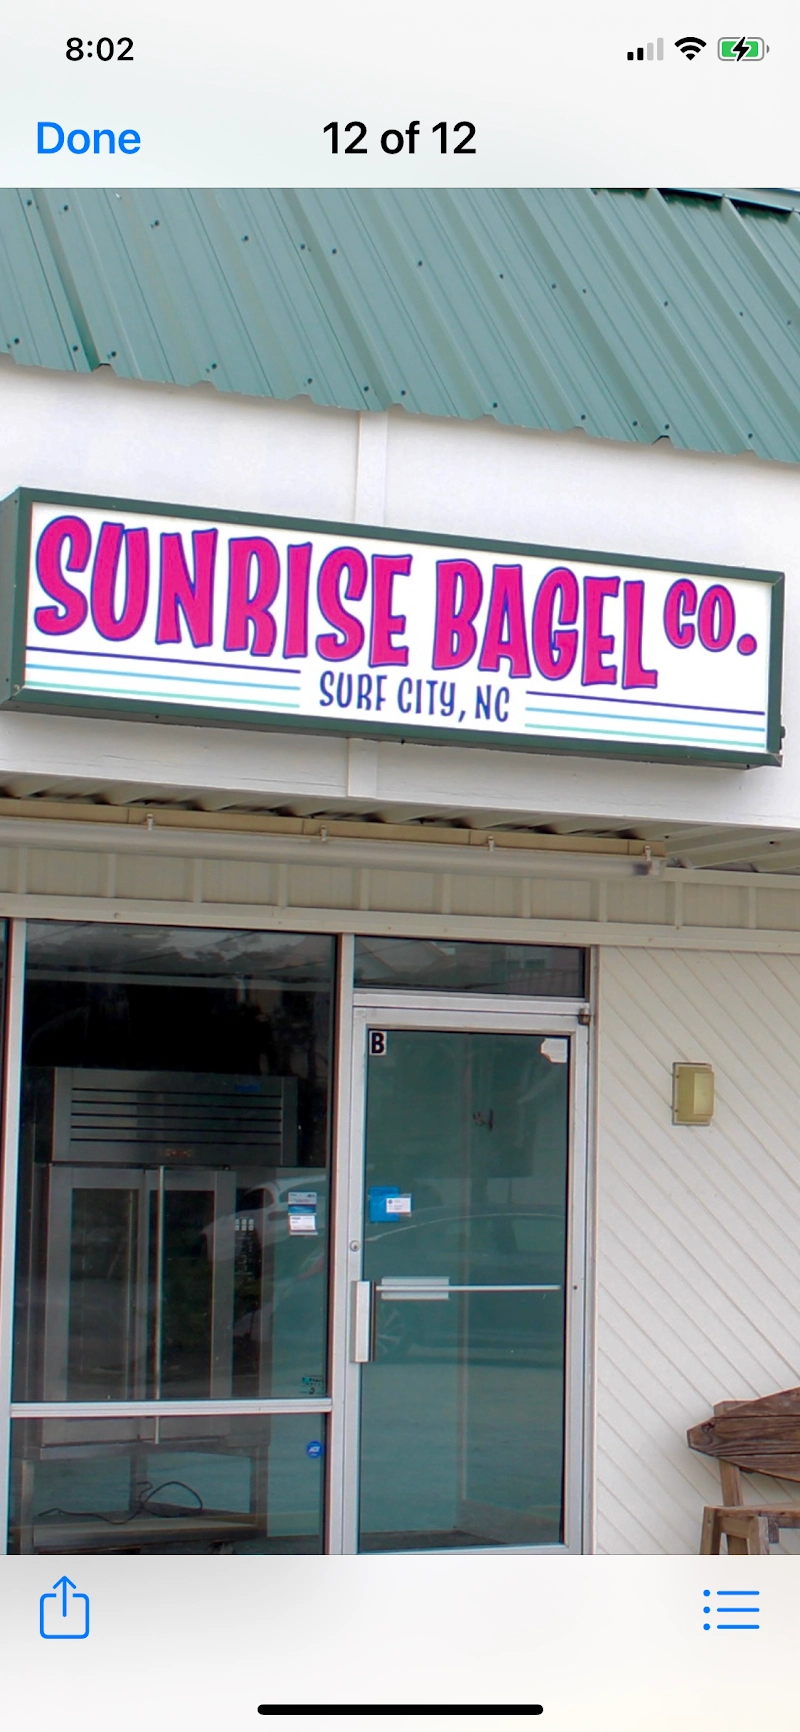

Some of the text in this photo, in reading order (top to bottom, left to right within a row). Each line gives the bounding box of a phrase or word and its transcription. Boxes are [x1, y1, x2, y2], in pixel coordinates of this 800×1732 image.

[34, 514, 758, 690] SUNRISE BAGEL CO.
[319, 670, 510, 723] SURF CITY, NC
[371, 1032, 384, 1054] B
